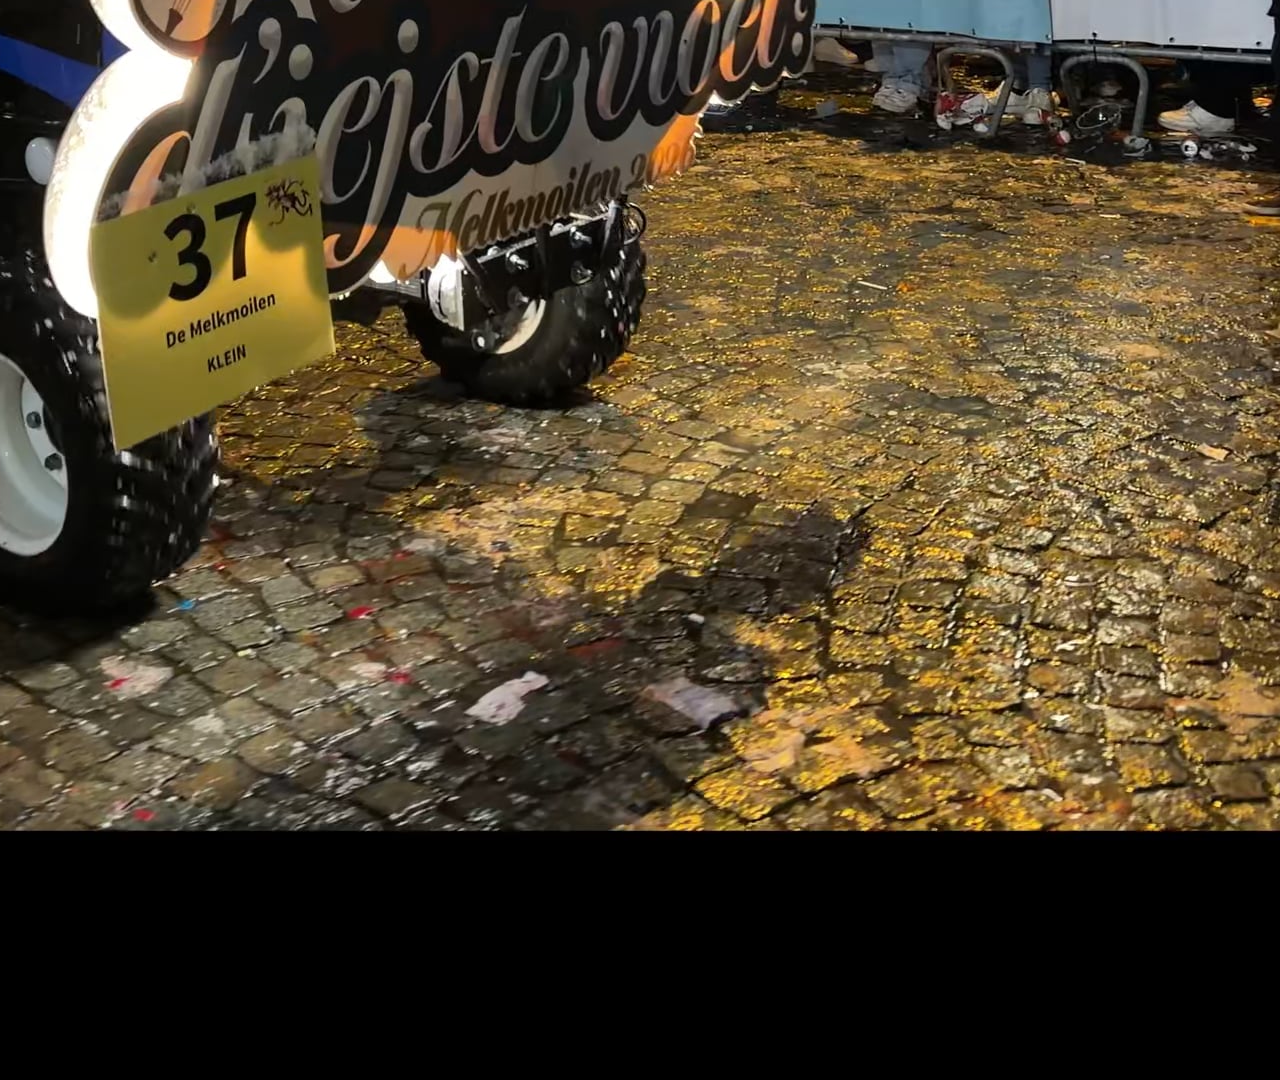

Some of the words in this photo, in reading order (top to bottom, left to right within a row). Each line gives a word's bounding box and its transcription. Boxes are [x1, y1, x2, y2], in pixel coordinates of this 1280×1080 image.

[163, 192, 258, 302] 37
[403, 158, 623, 277] Melkmoilen
[165, 325, 186, 349] De
[189, 291, 276, 339] Melkmoilen
[206, 343, 247, 373] KLEIN
